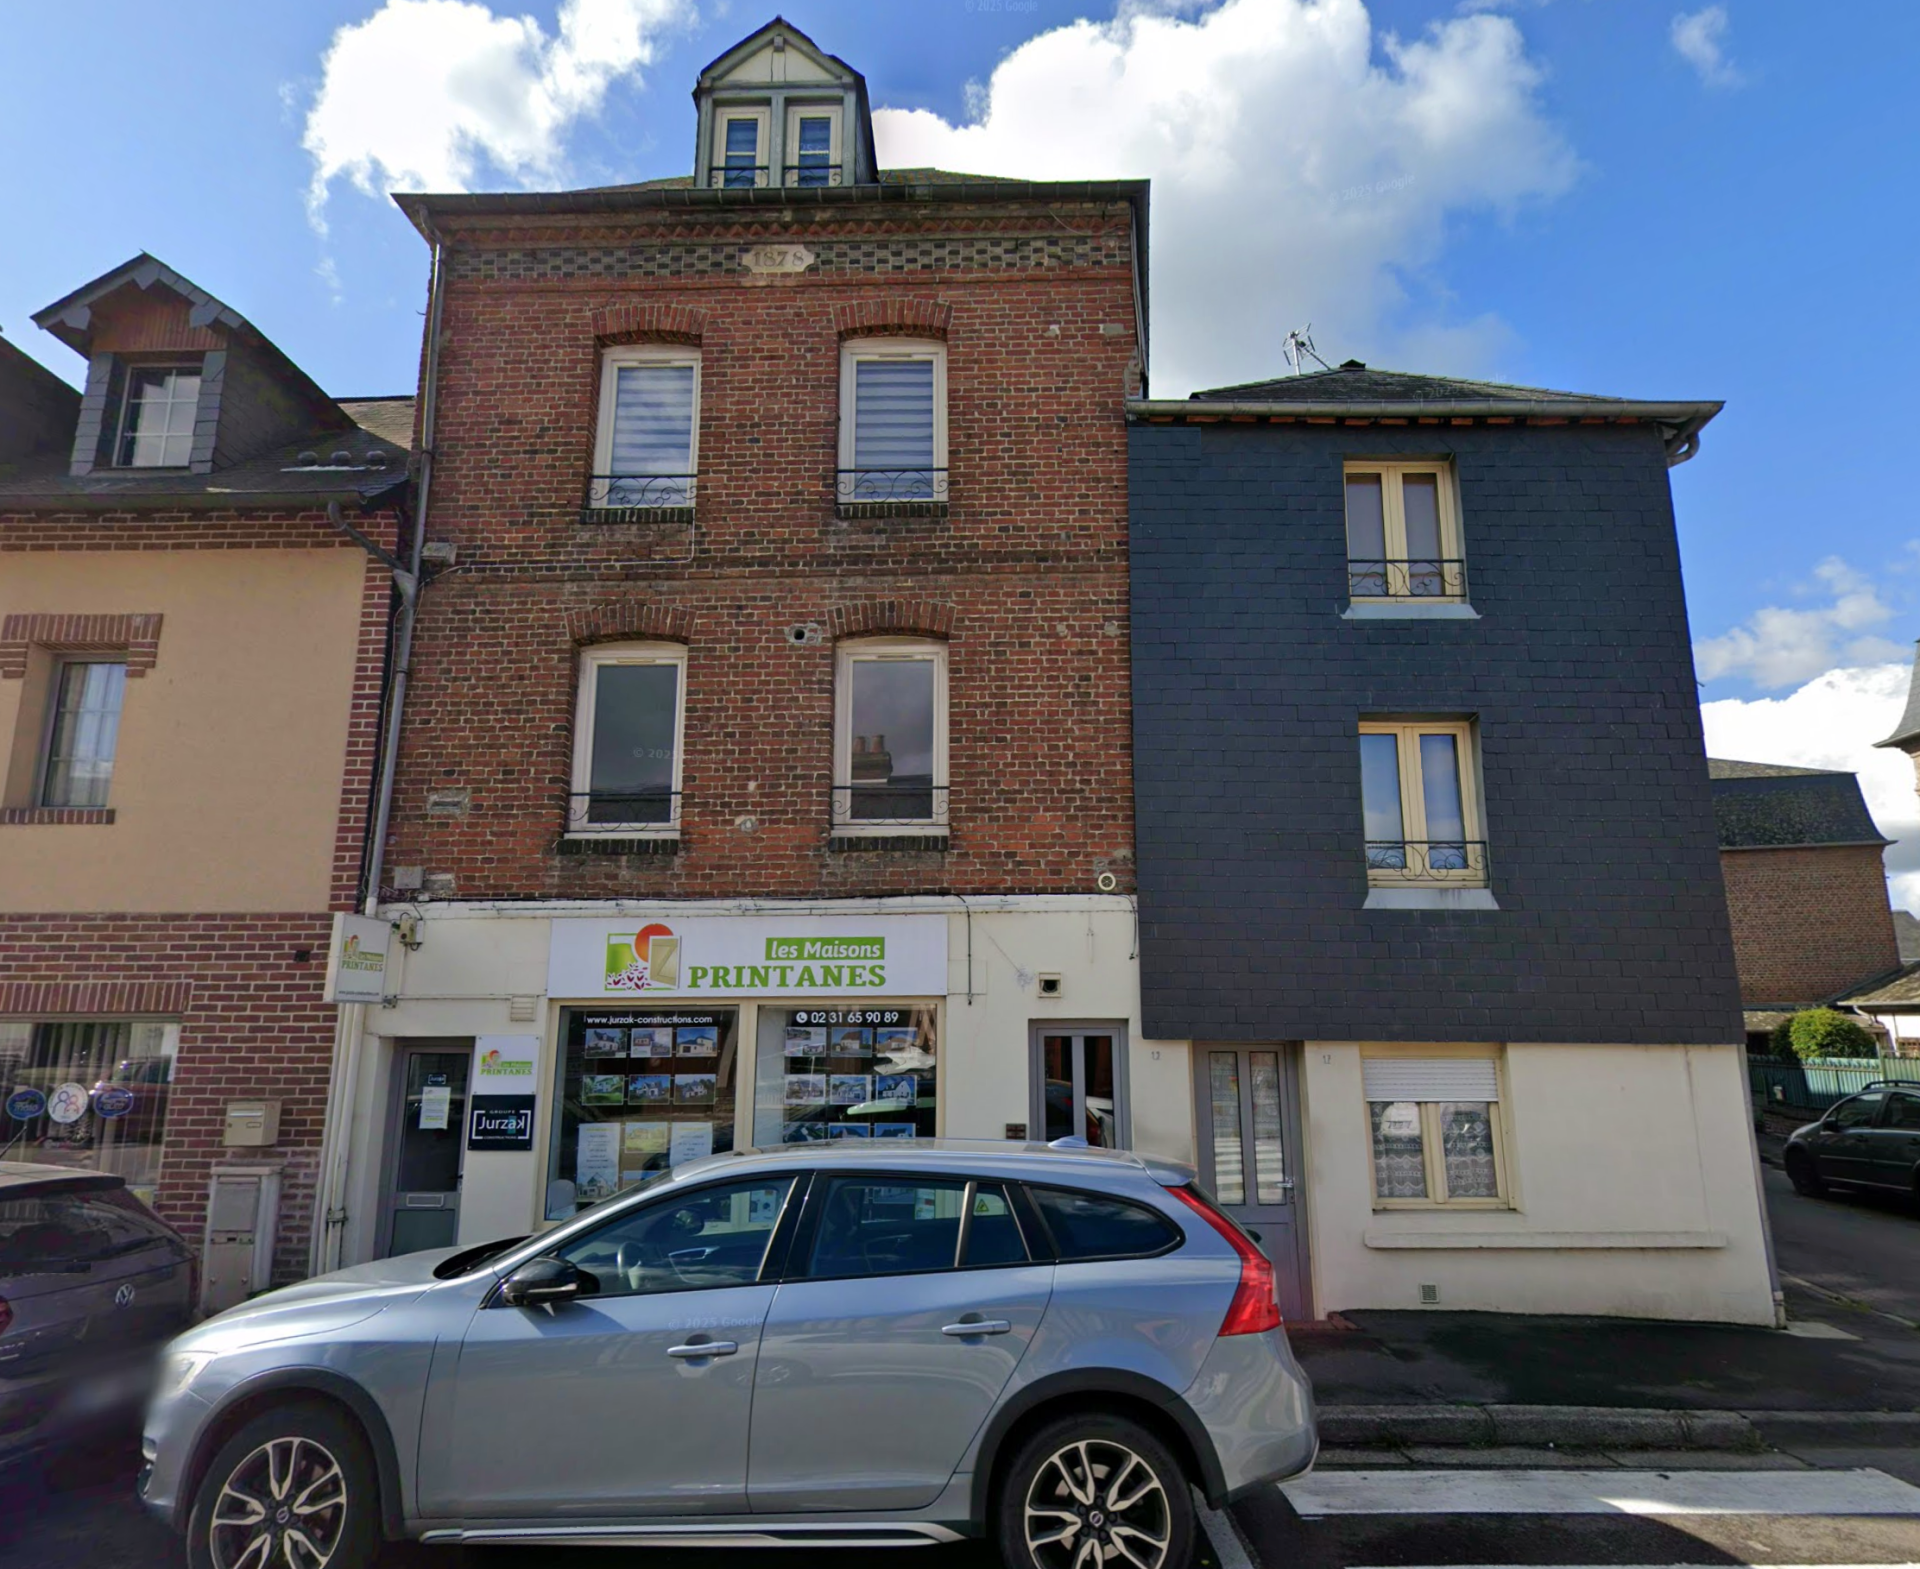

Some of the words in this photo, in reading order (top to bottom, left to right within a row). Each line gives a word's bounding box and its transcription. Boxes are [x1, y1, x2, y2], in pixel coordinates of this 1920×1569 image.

[753, 250, 804, 267] 1878
[770, 940, 798, 958] les
[803, 940, 881, 958] Maisons
[341, 960, 384, 972] PRINTANES
[687, 964, 887, 988] PRINTANES
[587, 1015, 713, 1025] www.jurzak-constructions.com
[810, 1011, 826, 1023] 02
[829, 1011, 843, 1023] 31
[847, 1011, 863, 1023] 65
[865, 1011, 881, 1023] 90
[884, 1011, 899, 1023] 89
[480, 1068, 533, 1076] PRINTANES
[478, 1115, 526, 1130] Jurzak
